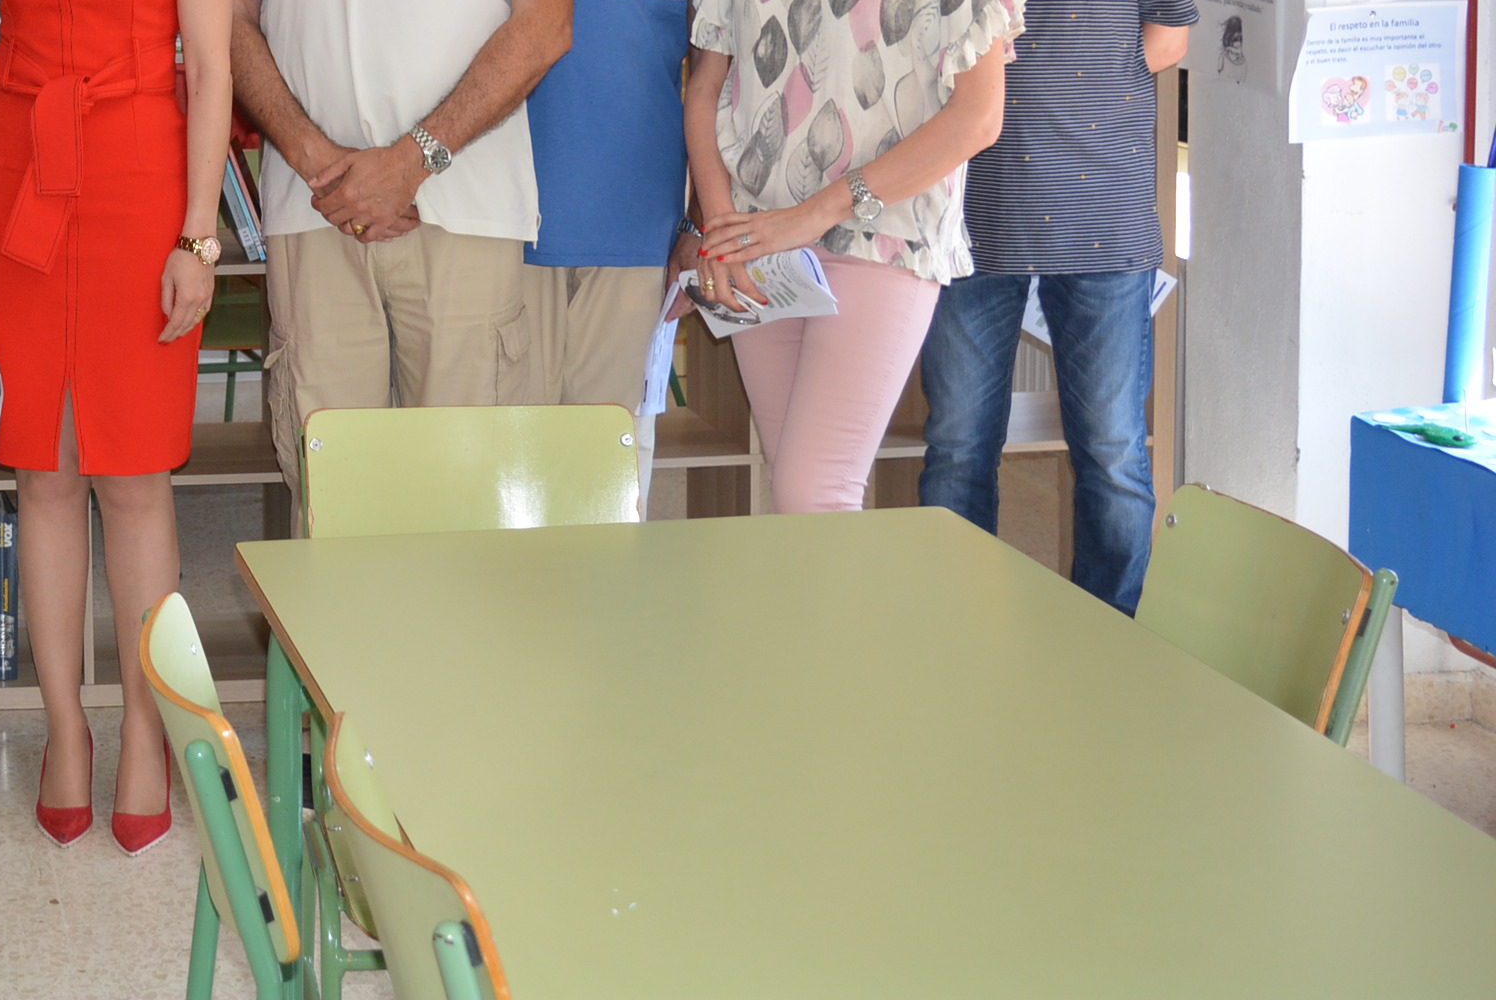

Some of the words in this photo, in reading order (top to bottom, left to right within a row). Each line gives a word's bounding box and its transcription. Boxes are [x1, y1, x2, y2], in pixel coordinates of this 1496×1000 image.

[1330, 23, 1336, 31] El
[1338, 21, 1367, 30] respeto
[1391, 19, 1419, 27] familia
[4, 523, 12, 548] VOX
